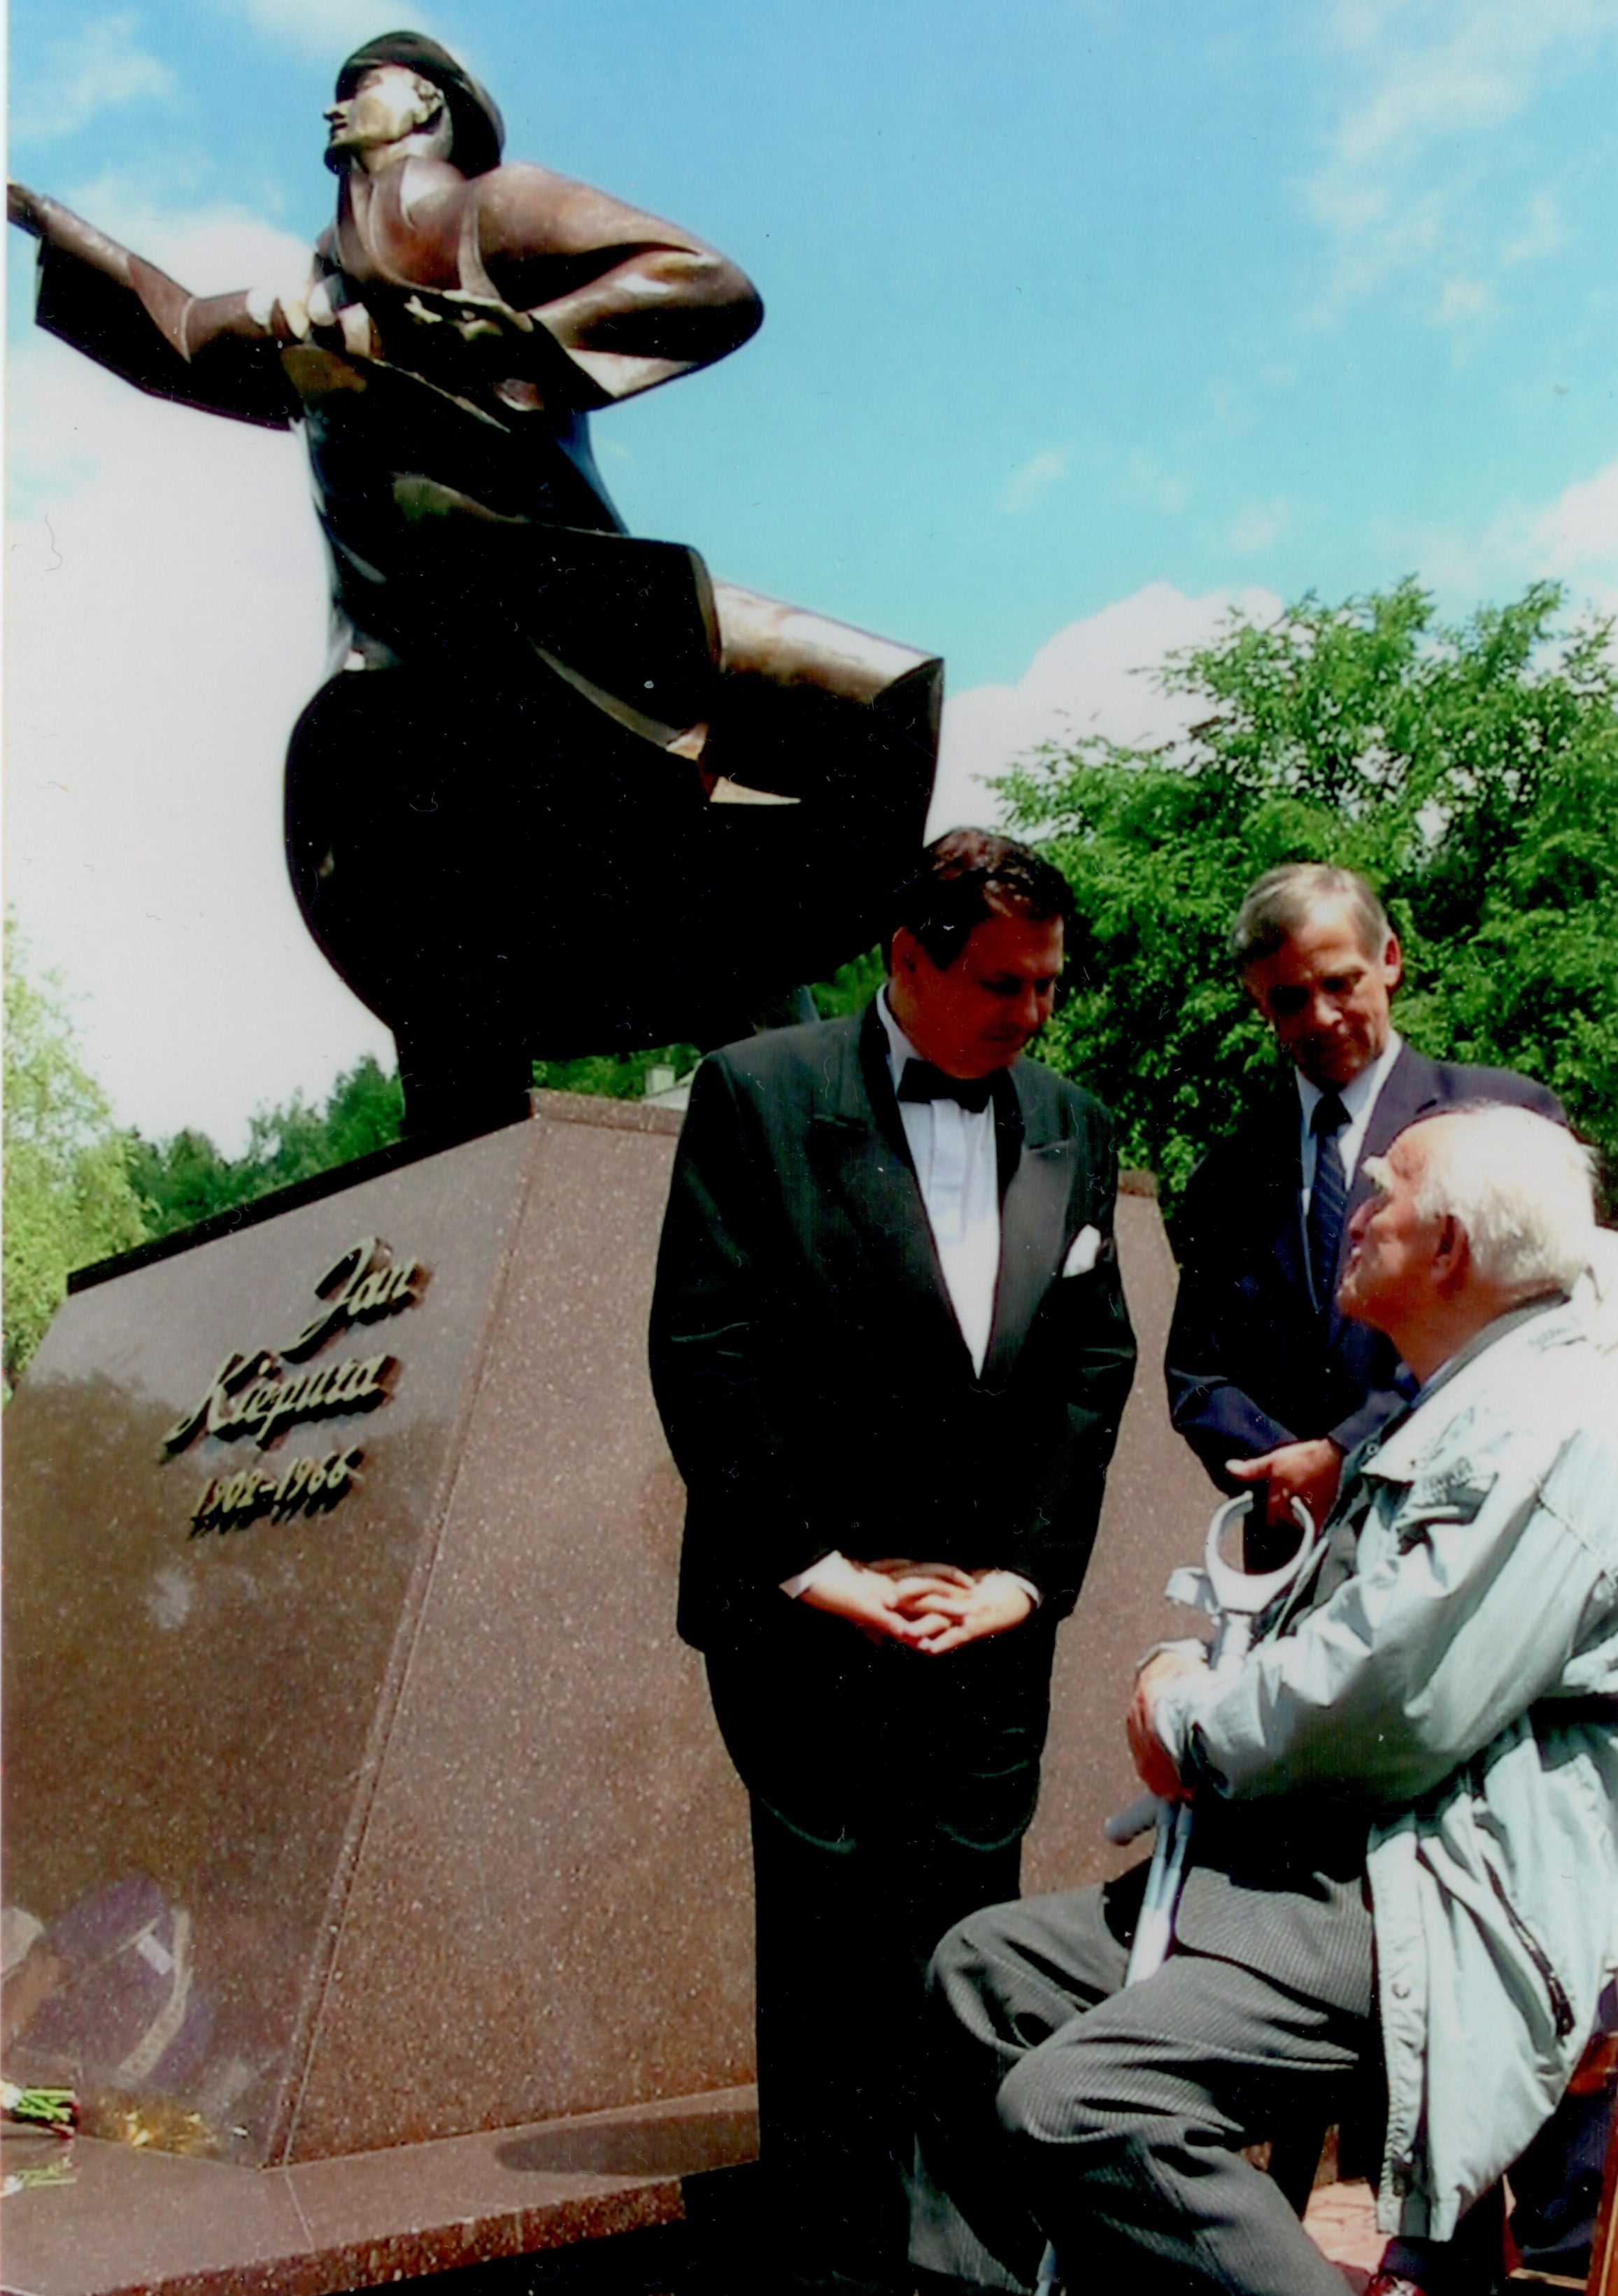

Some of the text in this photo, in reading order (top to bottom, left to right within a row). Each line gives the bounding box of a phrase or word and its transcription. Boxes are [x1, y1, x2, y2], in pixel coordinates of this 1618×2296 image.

[280, 1236, 420, 1357] Jan
[161, 1350, 389, 1448] Kiepura
[189, 1444, 358, 1519] 1902-1966
